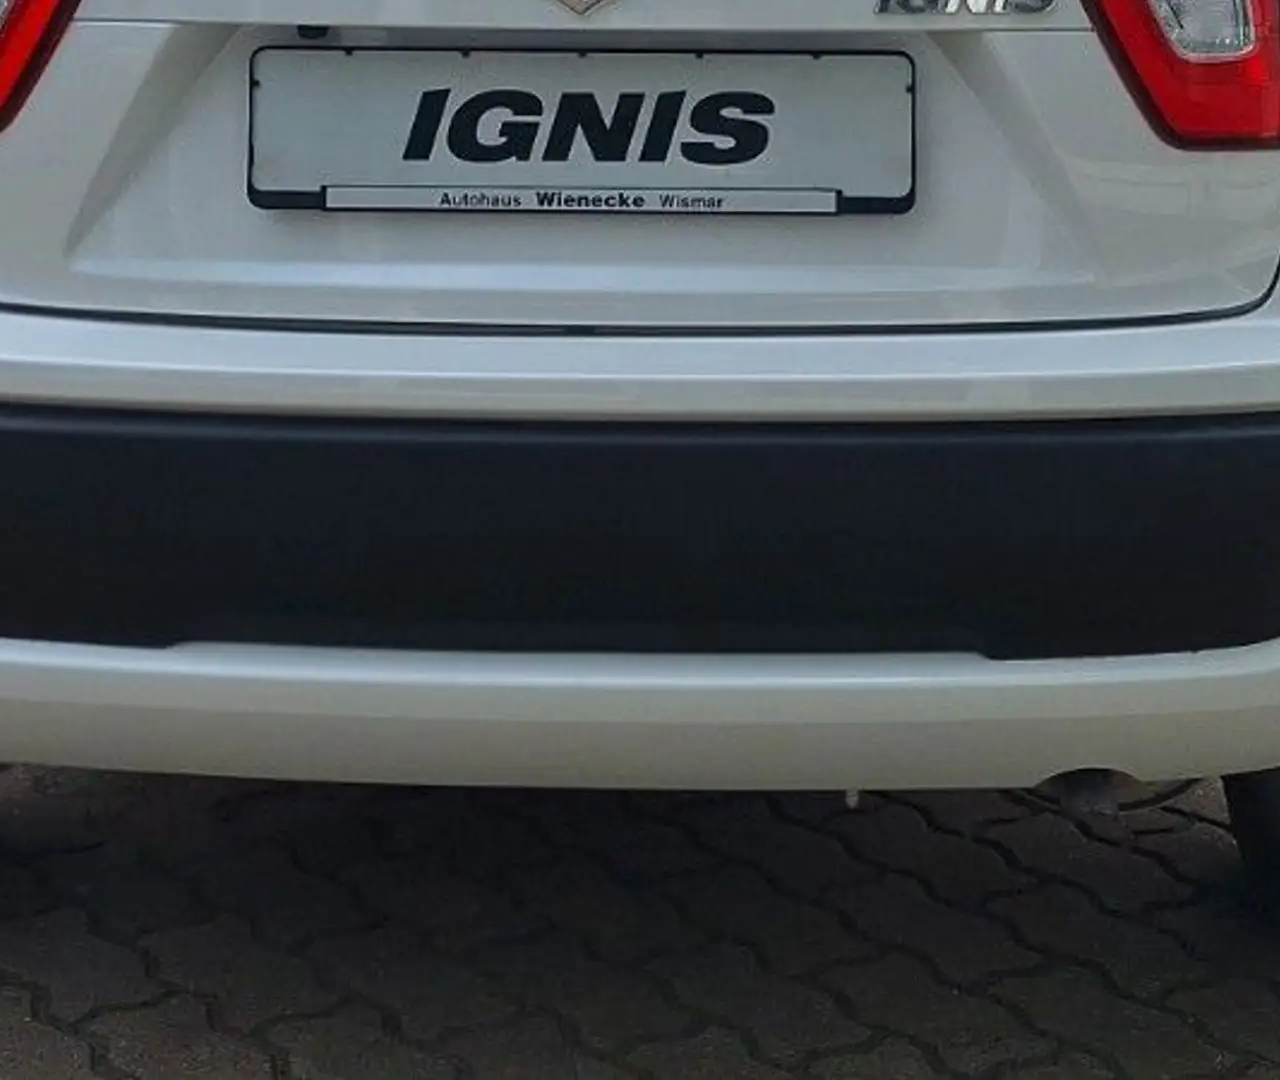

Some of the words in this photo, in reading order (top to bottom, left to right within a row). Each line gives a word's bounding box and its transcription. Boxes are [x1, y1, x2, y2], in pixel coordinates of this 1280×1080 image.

[402, 88, 775, 165] IGNIS
[439, 192, 522, 208] Autohaus
[535, 191, 646, 208] Wienecke
[659, 194, 724, 209] Wismar
